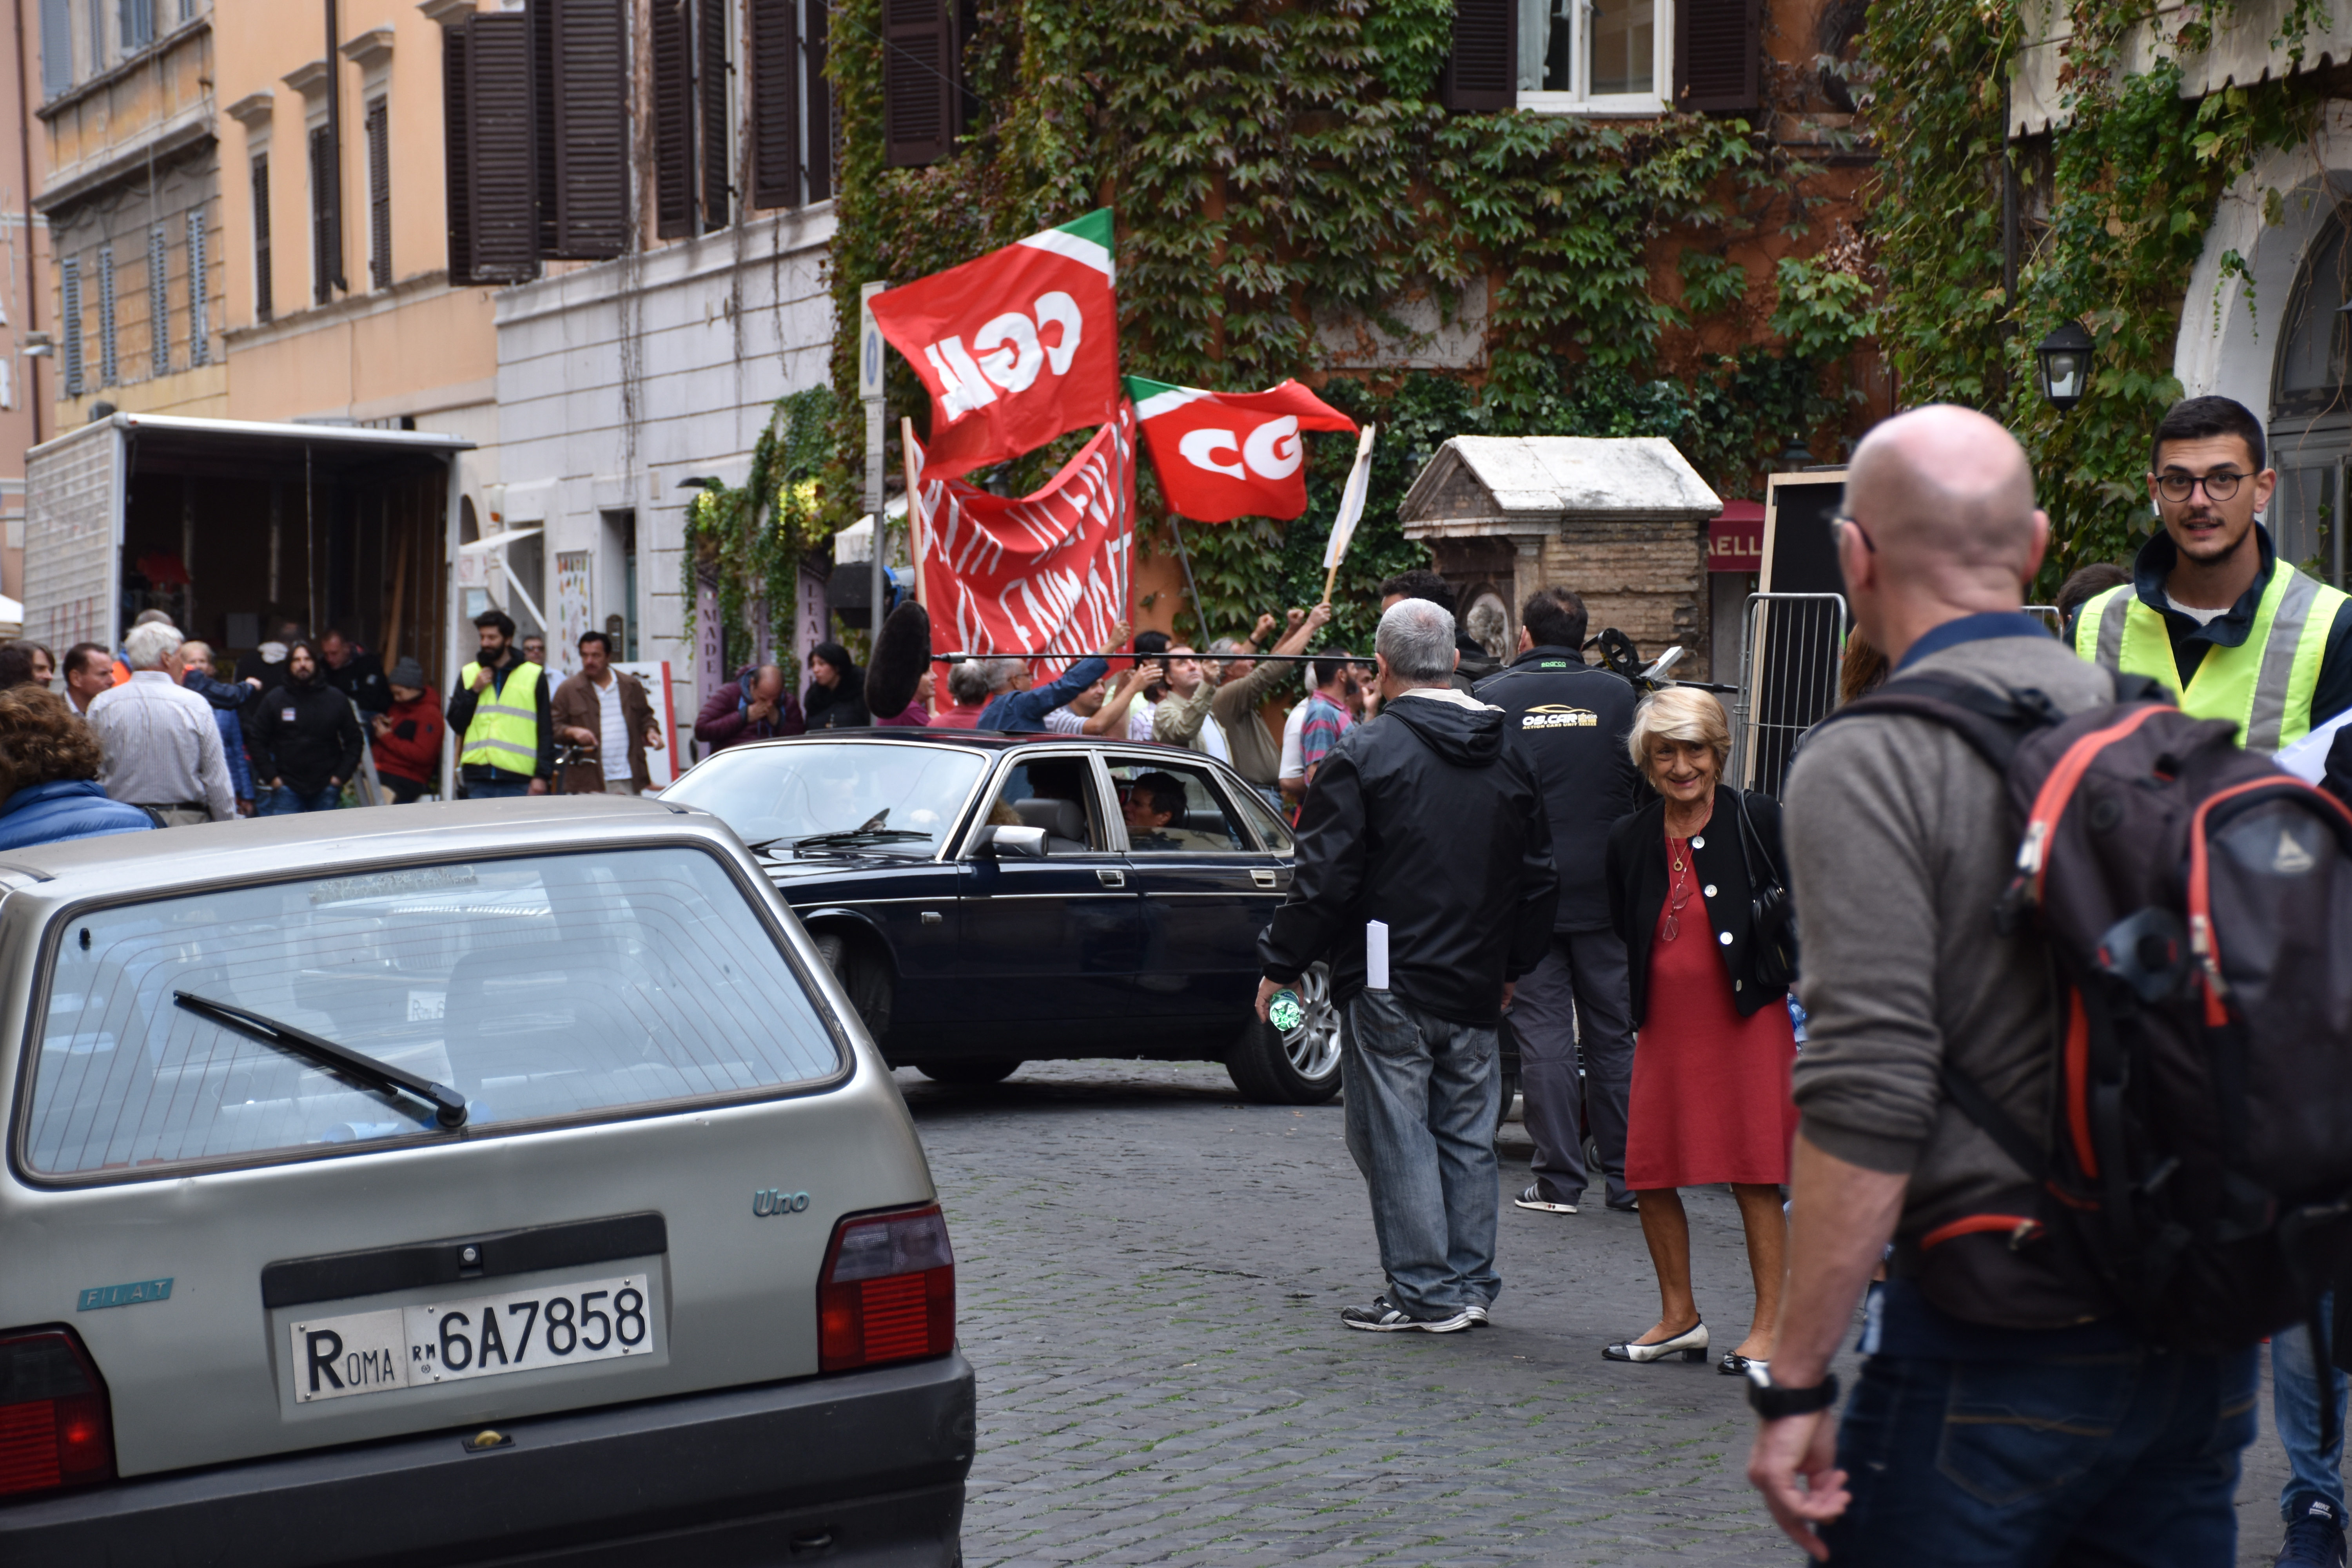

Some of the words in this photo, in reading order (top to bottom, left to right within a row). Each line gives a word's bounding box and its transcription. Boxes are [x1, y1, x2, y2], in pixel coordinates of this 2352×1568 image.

[704, 609, 717, 674] MADE
[1523, 713, 1578, 726] OS.CAR
[753, 1188, 809, 1217] Uno
[86, 1281, 167, 1307] FIAT
[413, 1343, 436, 1361] RM
[439, 1287, 646, 1371] 6A7858
